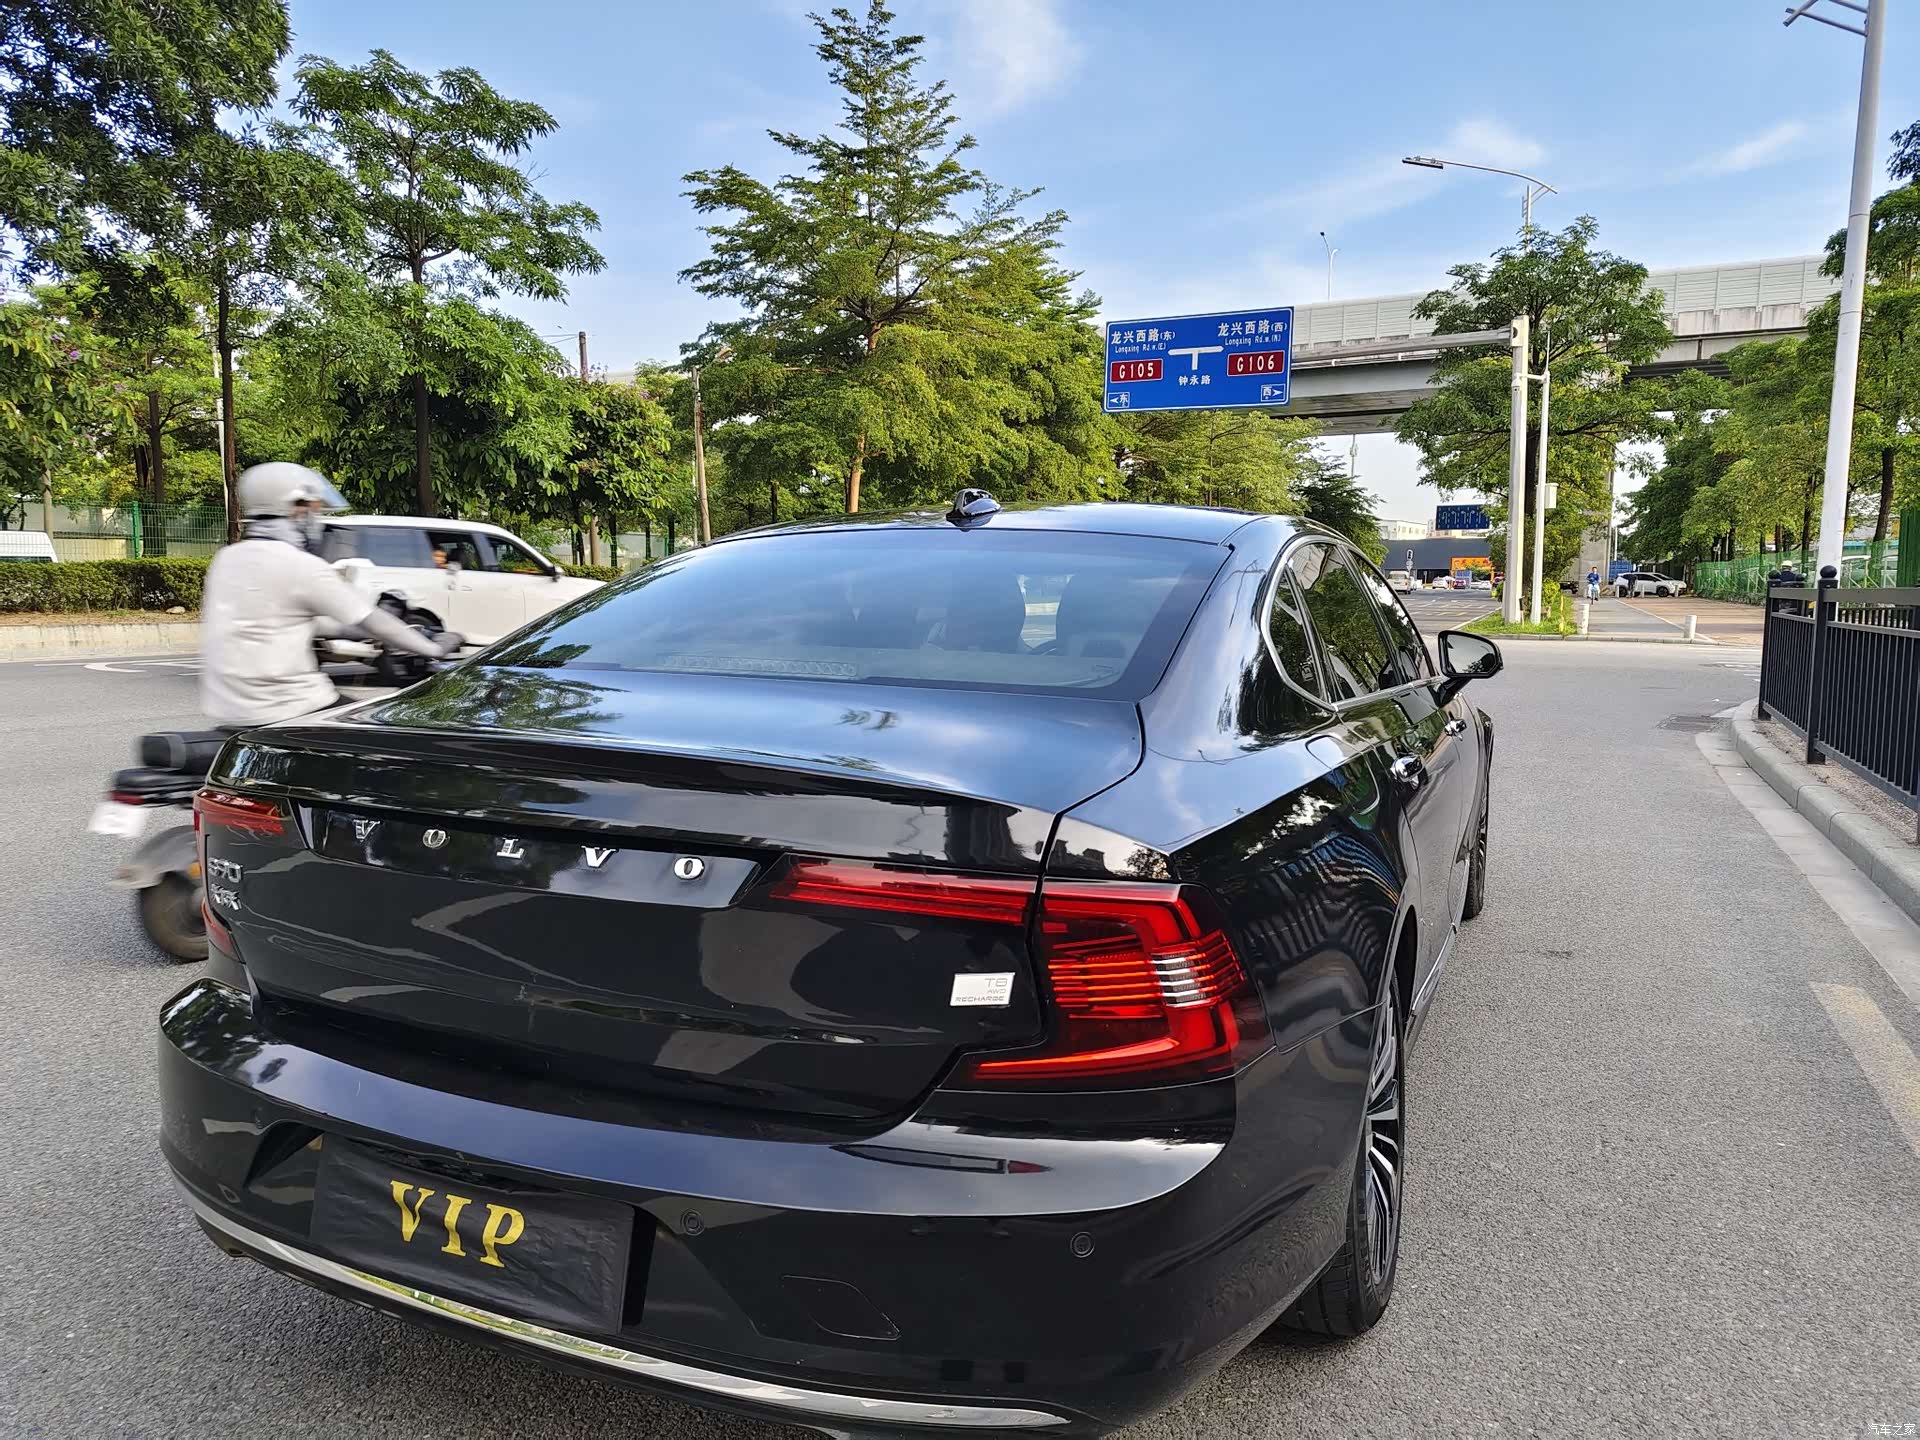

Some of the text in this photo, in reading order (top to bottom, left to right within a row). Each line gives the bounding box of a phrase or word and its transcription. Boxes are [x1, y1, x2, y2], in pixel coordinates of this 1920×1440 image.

[1119, 362, 1153, 379] G105
[1237, 354, 1275, 372] G106
[353, 819, 705, 881] VOLVO
[984, 978, 1008, 988] T8
[390, 1180, 526, 1268] VIP
